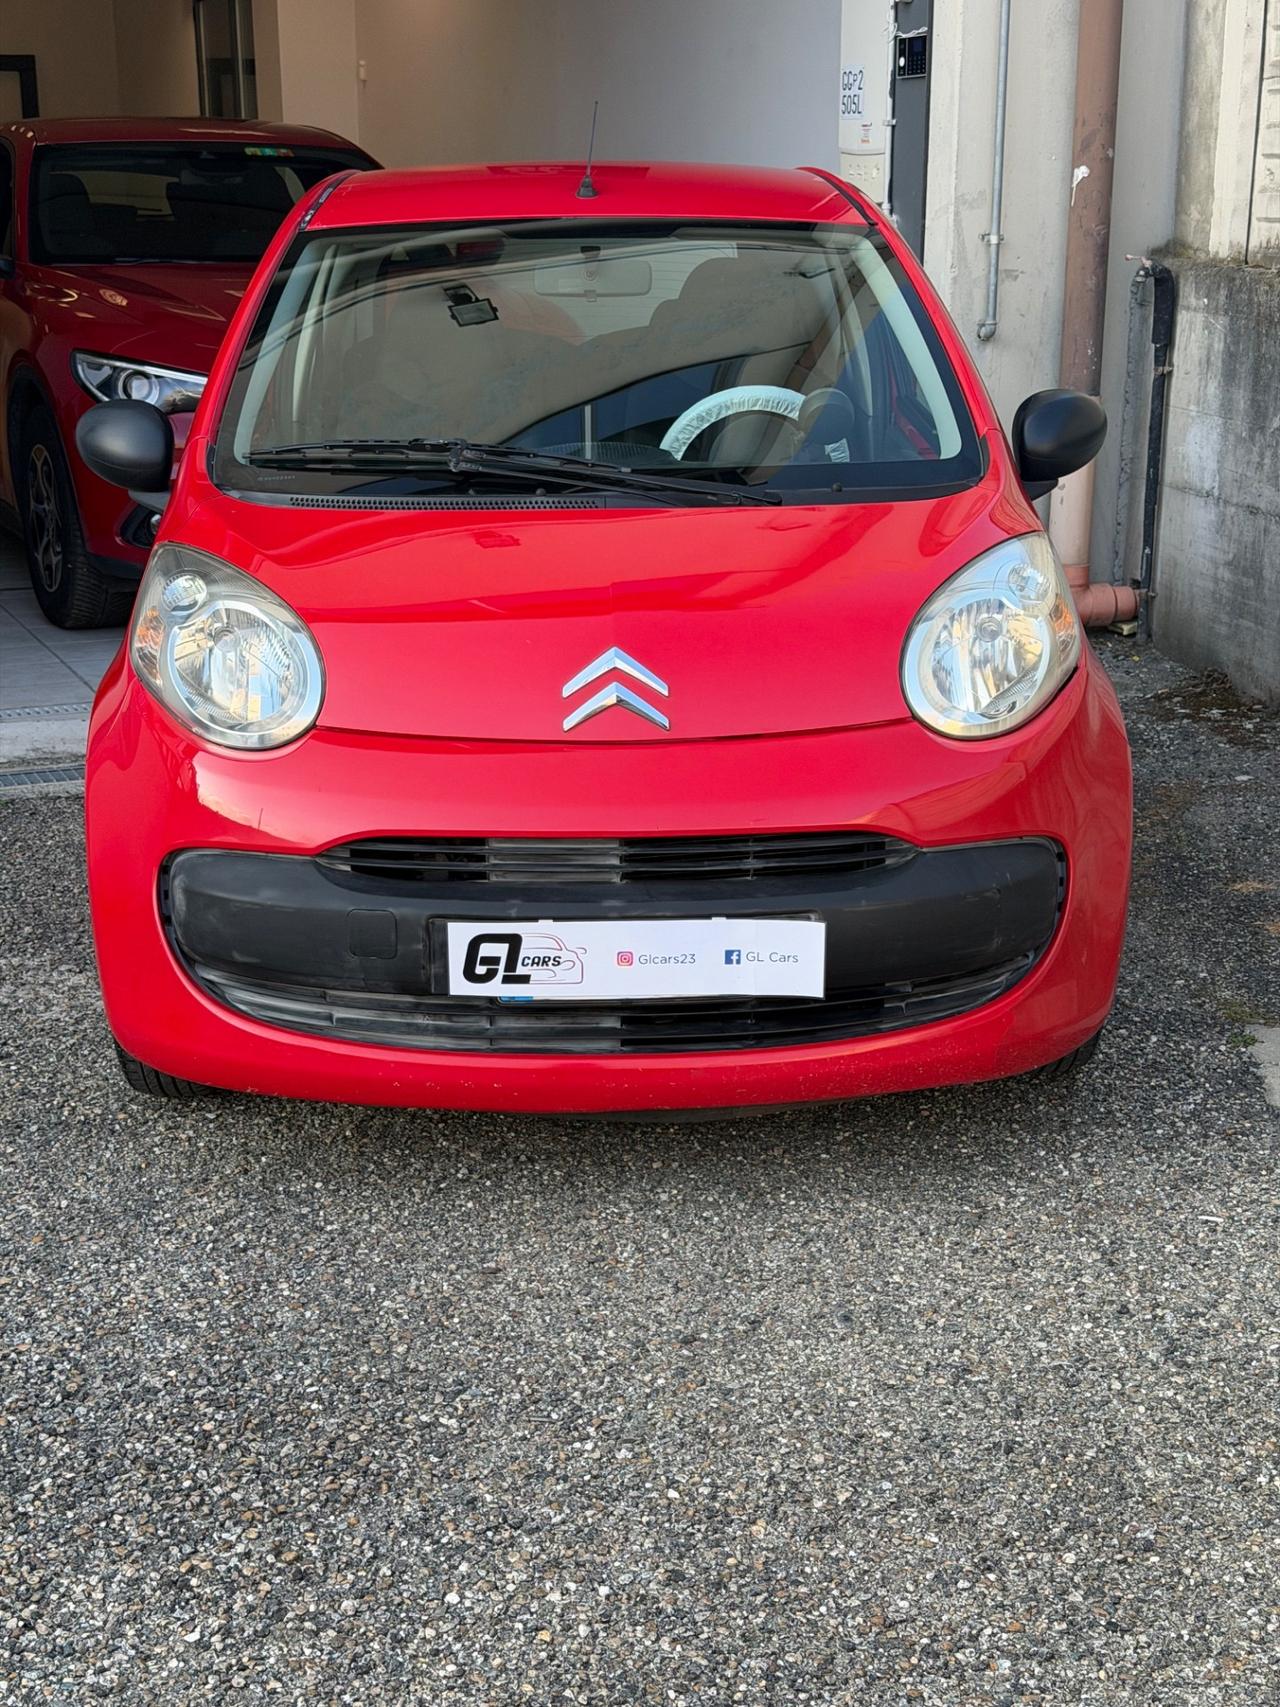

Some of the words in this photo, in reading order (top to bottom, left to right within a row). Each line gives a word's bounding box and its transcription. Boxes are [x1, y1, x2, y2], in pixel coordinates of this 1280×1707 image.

[463, 933, 531, 984] GL
[521, 955, 562, 967] CARS
[745, 951, 764, 963] GL
[769, 951, 799, 964] Cars
